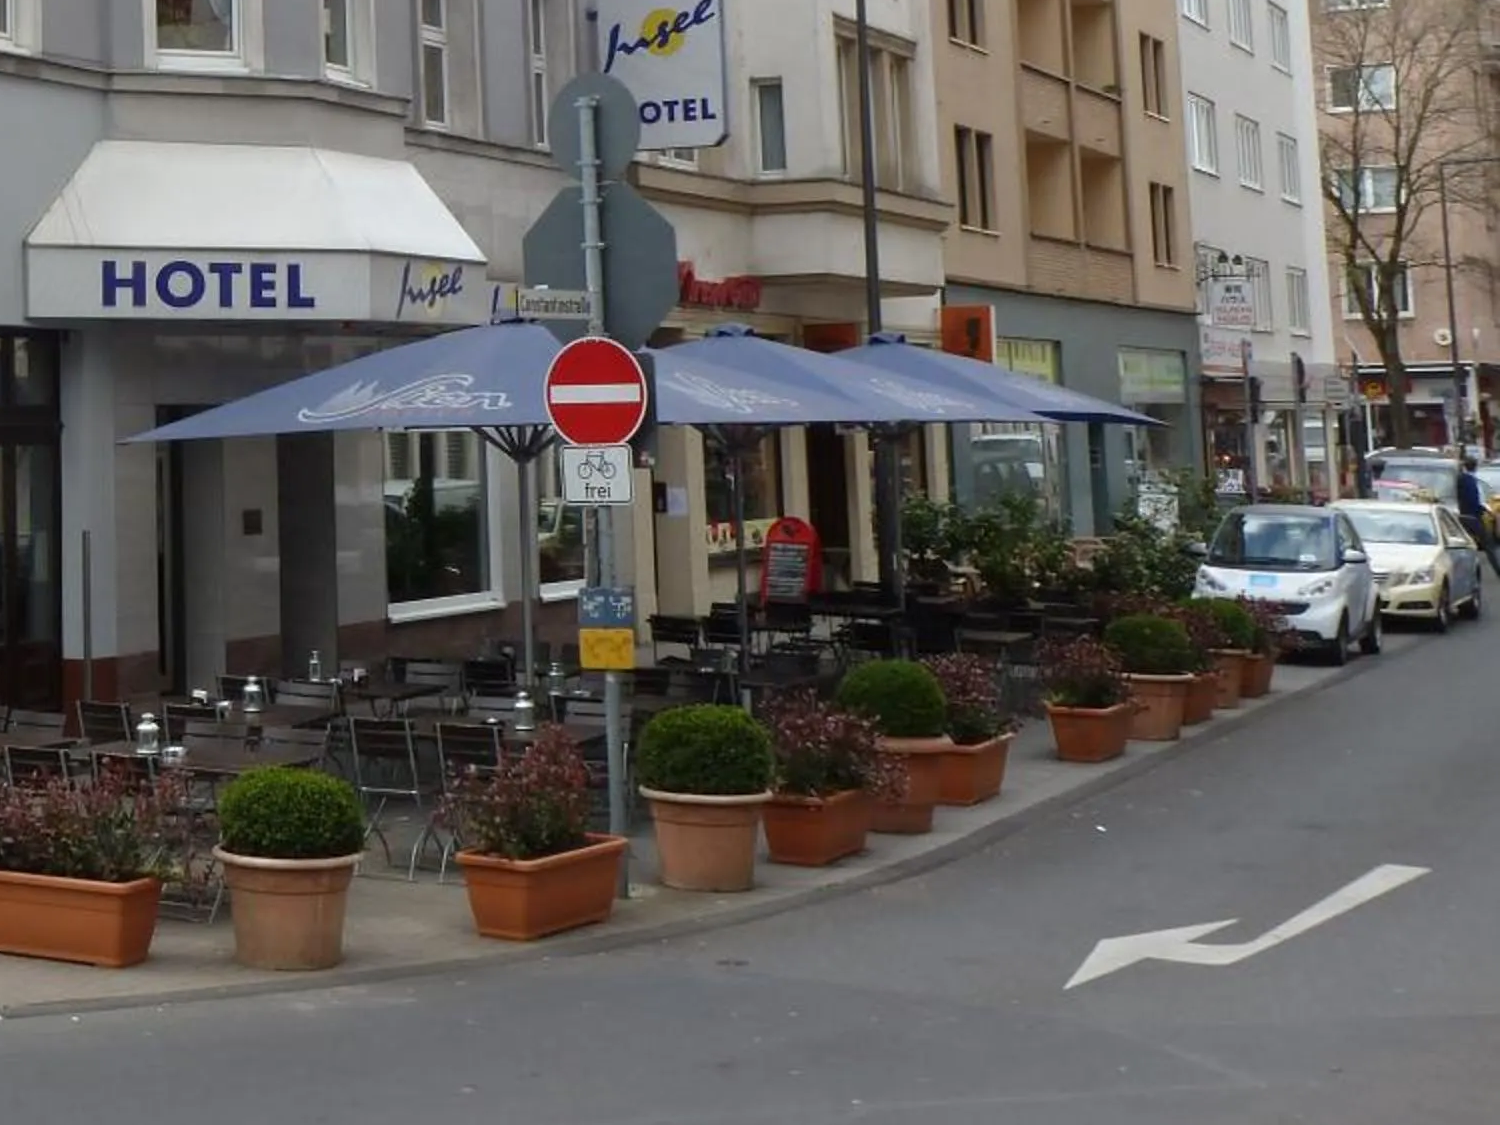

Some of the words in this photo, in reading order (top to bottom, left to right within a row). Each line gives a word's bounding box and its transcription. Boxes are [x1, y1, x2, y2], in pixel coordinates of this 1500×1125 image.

[638, 97, 717, 125] OTEL
[101, 260, 315, 308] HOTEL
[585, 482, 612, 499] frei
